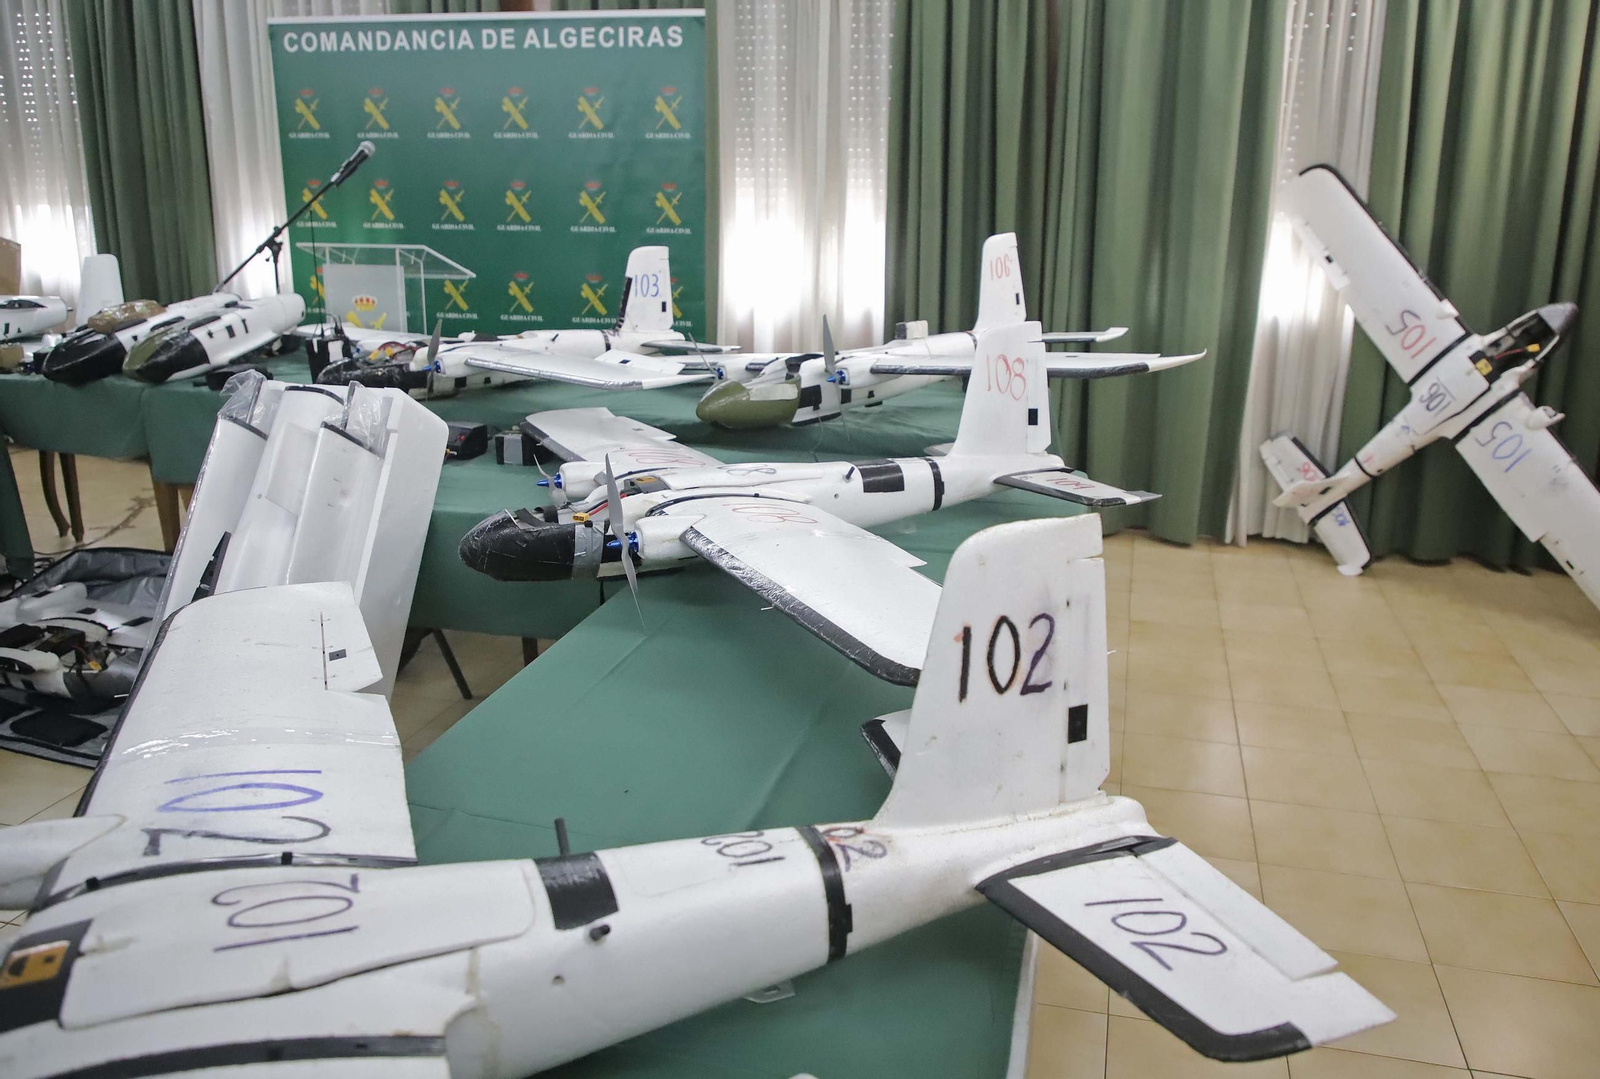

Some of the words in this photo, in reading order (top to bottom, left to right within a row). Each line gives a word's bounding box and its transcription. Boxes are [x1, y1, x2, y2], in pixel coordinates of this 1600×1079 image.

[283, 28, 474, 52] COMANDANCIA
[481, 27, 516, 49] DE
[523, 25, 684, 49] ALGECIRAS
[635, 273, 660, 298] 103
[990, 253, 1011, 281] 106
[1385, 309, 1437, 359] 105
[987, 353, 1027, 401] 108
[1475, 420, 1533, 473] 105
[954, 612, 1055, 703] 102
[140, 769, 332, 857] 102
[211, 873, 361, 953] 102
[1085, 898, 1228, 971] 102
